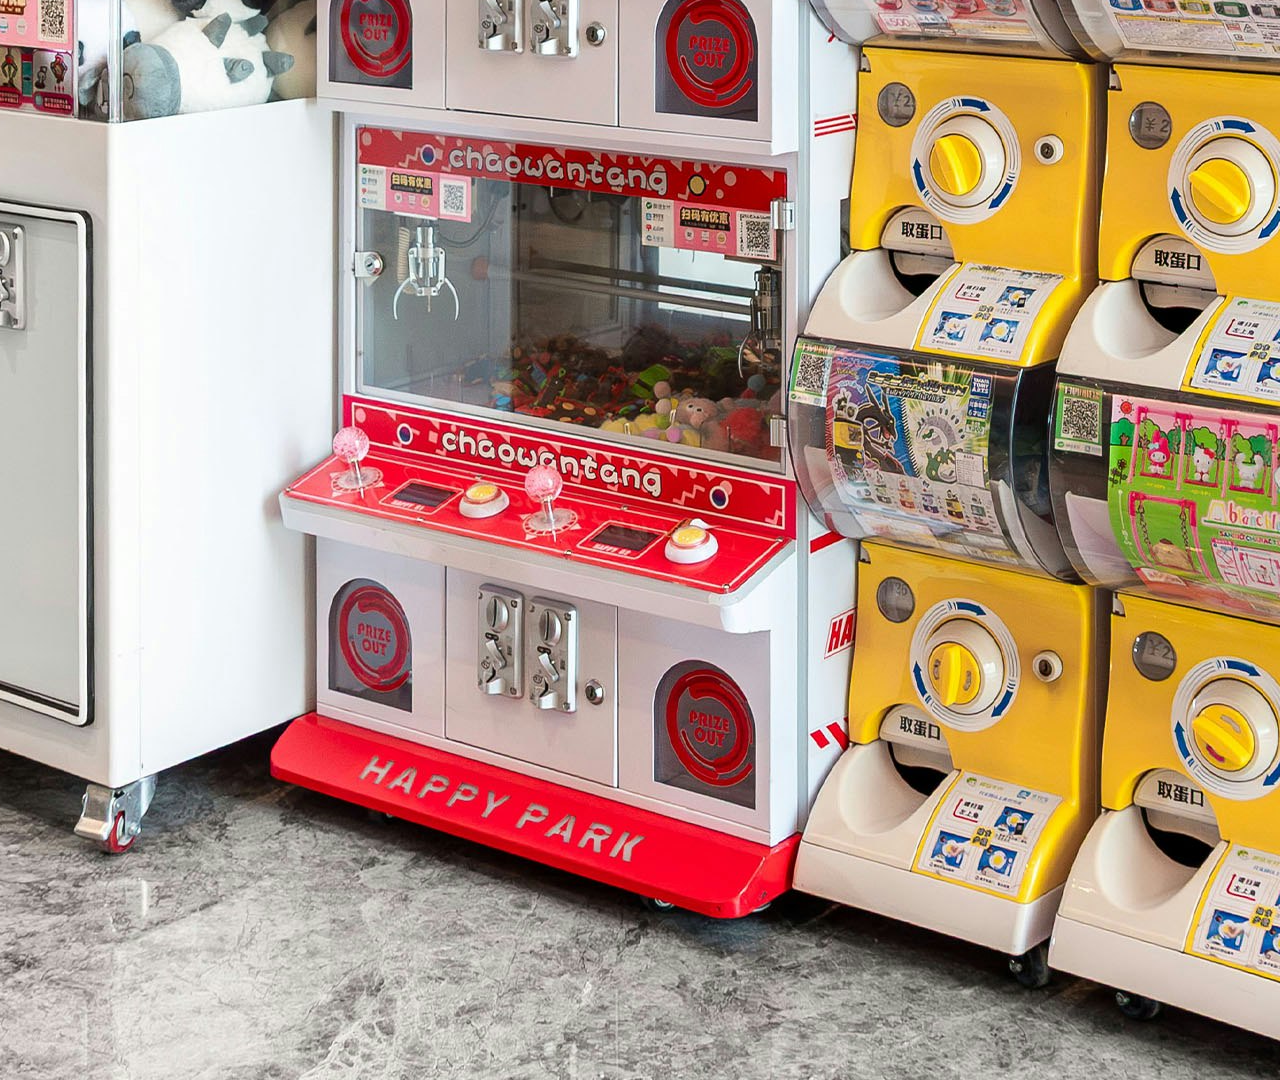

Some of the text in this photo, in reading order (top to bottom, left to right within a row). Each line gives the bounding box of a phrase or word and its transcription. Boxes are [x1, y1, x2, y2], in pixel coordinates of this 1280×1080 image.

[359, 12, 393, 29] PRIZE
[362, 27, 389, 42] OUT
[688, 34, 730, 53] PRIZE
[693, 51, 726, 70] OUT
[449, 145, 668, 196] chaowantang
[681, 208, 729, 225] 扫码有优惠
[901, 221, 943, 240] 取蛋口
[1154, 249, 1202, 271] 取蛋口
[442, 430, 663, 498] chaowantang
[356, 623, 393, 643] PRIZE
[827, 613, 856, 654] HA
[361, 639, 388, 658] OUT
[688, 710, 731, 733] PRIZE
[900, 715, 942, 741] 取蛋口
[693, 728, 725, 748] OUT
[1157, 779, 1205, 808] 取蛋口
[358, 755, 646, 863] HAPPY PARK
